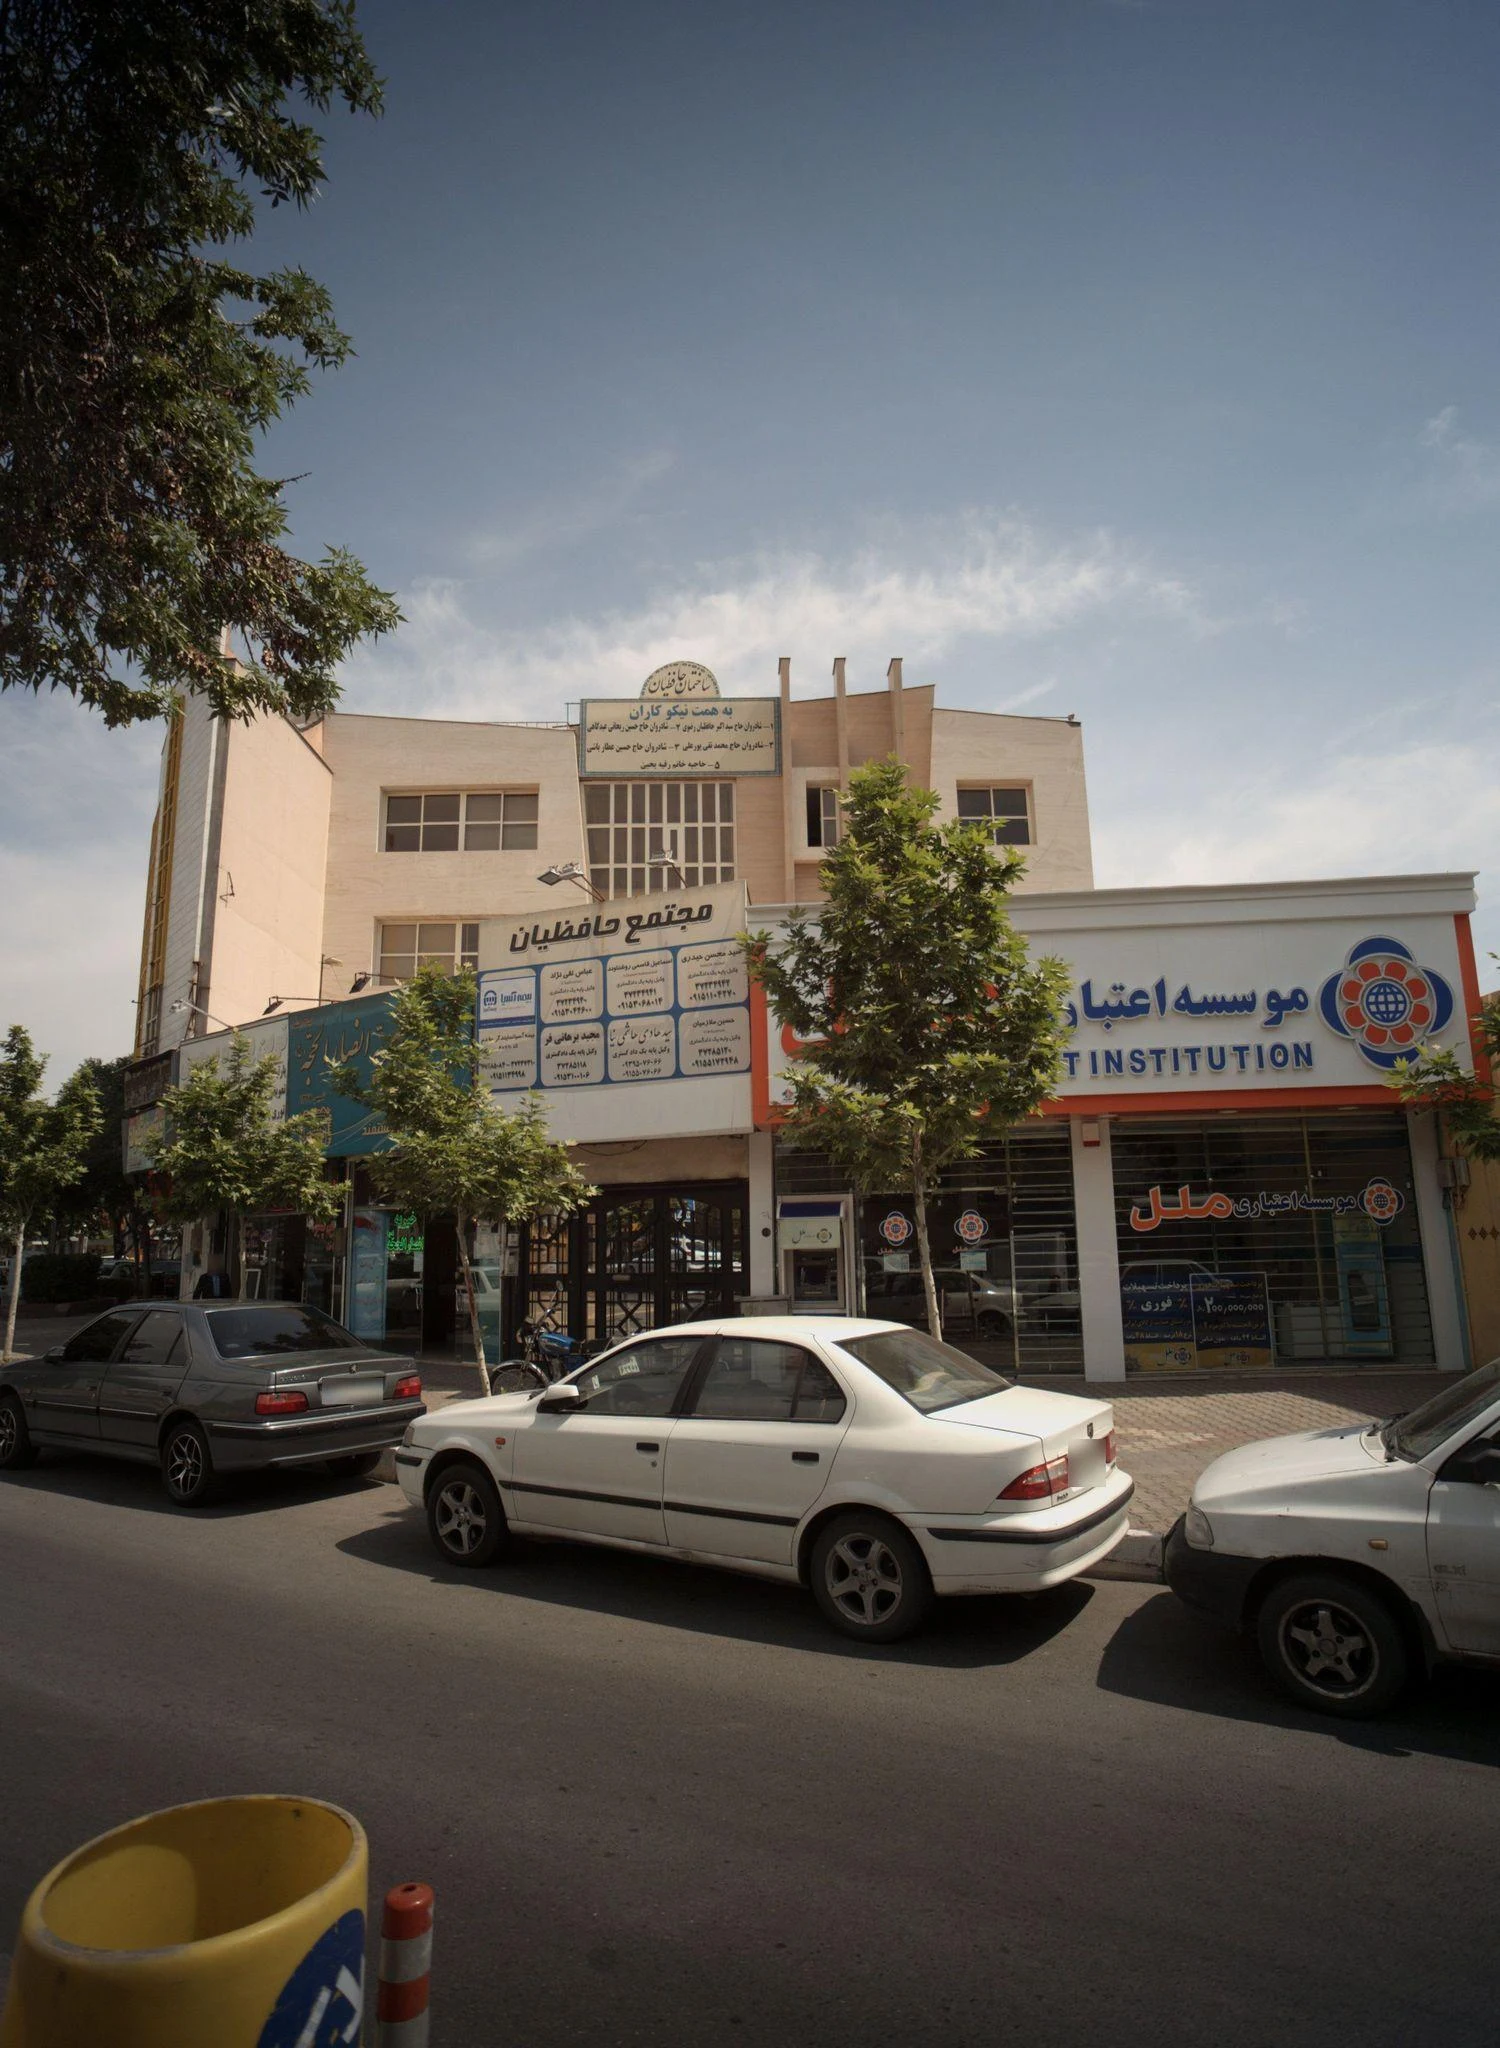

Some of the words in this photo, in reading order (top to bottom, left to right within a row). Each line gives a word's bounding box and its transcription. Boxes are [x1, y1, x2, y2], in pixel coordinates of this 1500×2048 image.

[674, 670, 711, 694] ساختمان
[629, 704, 662, 720] کاران
[666, 704, 689, 720] نیکو
[691, 705, 719, 717] همت
[722, 706, 733, 718] به
[509, 914, 621, 953] حافظیان
[625, 903, 713, 944] مجتمع
[1052, 976, 1167, 1031] اعتبار
[1173, 984, 1309, 1028] موسسه
[581, 1032, 600, 1042] مجید
[1090, 1042, 1314, 1076] INSTITUTION
[1129, 1184, 1233, 1232] ملل
[1232, 1190, 1298, 1219] اعتباری
[1298, 1192, 1357, 1216] موسسه
[1141, 1296, 1173, 1312] فوری
